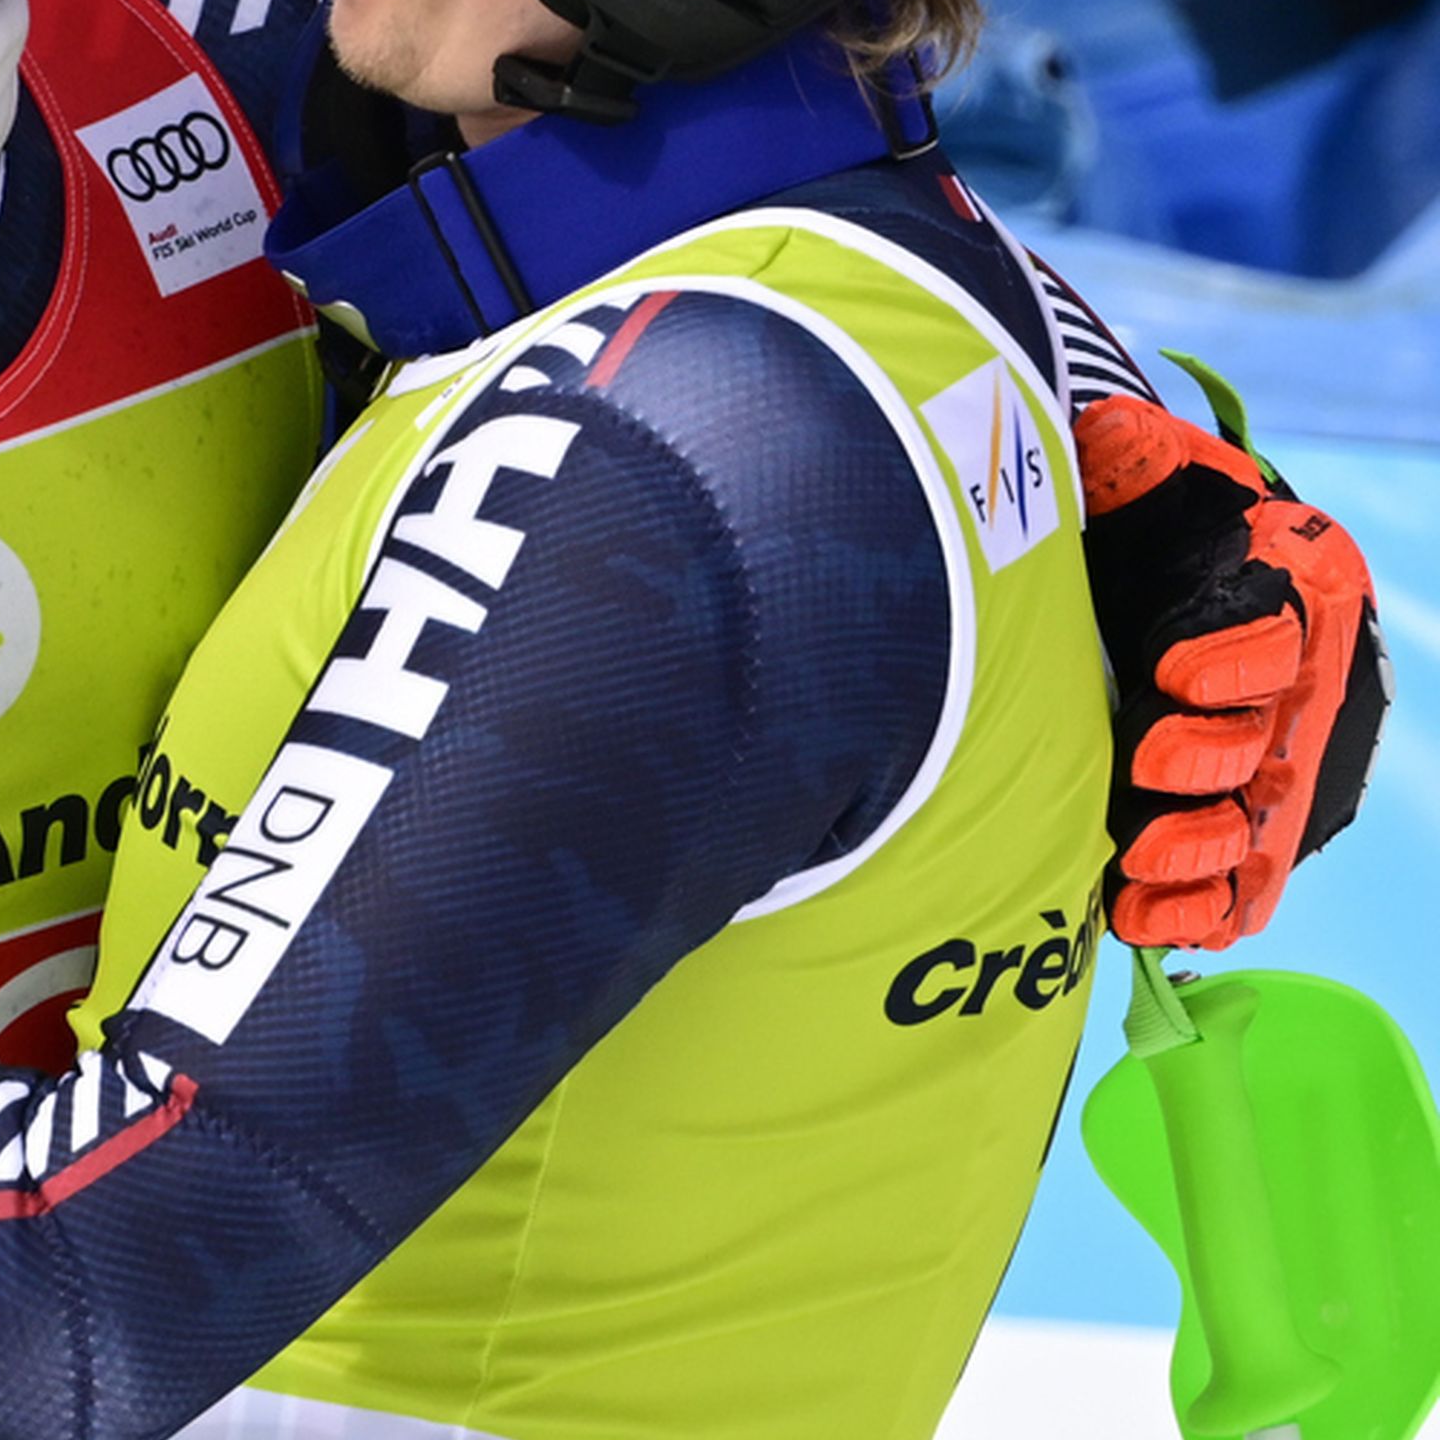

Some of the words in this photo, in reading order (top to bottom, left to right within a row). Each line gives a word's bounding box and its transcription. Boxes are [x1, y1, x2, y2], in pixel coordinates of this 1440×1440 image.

[148, 224, 178, 246] Audi
[152, 242, 175, 260] FIS
[175, 235, 197, 253] Ski
[194, 217, 234, 242] World
[233, 209, 257, 227] Cup
[970, 447, 1043, 523] FIS
[171, 784, 334, 972] DNB
